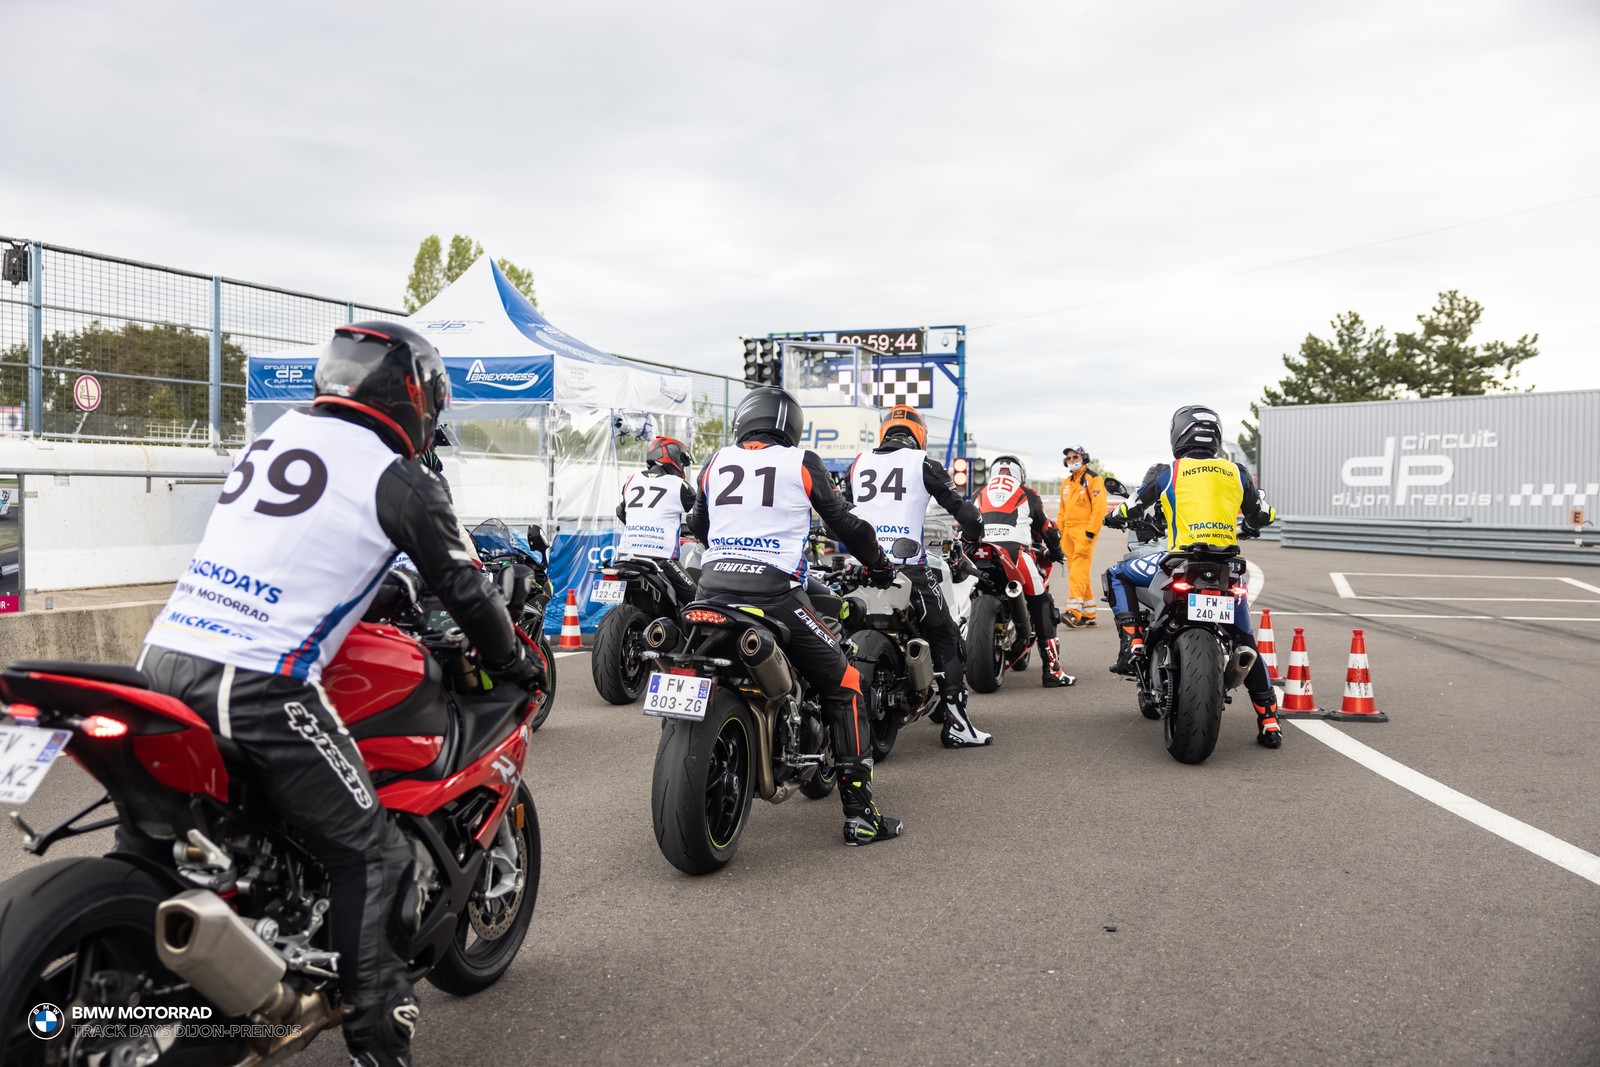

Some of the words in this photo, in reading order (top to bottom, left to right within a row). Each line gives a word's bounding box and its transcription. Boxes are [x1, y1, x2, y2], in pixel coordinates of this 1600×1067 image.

[1401, 430, 1498, 450] circuit
[217, 439, 328, 517] 59
[1182, 466, 1234, 477] INSTRUCTEUR
[715, 465, 777, 508] 21
[857, 467, 907, 503] 34
[988, 477, 1015, 493] 25
[627, 486, 668, 509] 27
[1331, 492, 1390, 508] dijon
[1573, 511, 1581, 523] E
[625, 525, 665, 534] TRACKDAYS
[1188, 521, 1234, 532] TRACKDAYS
[711, 537, 780, 548] TRACKDAYS
[713, 562, 767, 574] DAINESE
[197, 588, 270, 623] MOTORRAD
[1206, 597, 1218, 607] FW
[1219, 611, 1230, 621] AN
[793, 607, 836, 648] DAINESE
[666, 678, 685, 693] FW
[650, 694, 703, 713] 803-ZG
